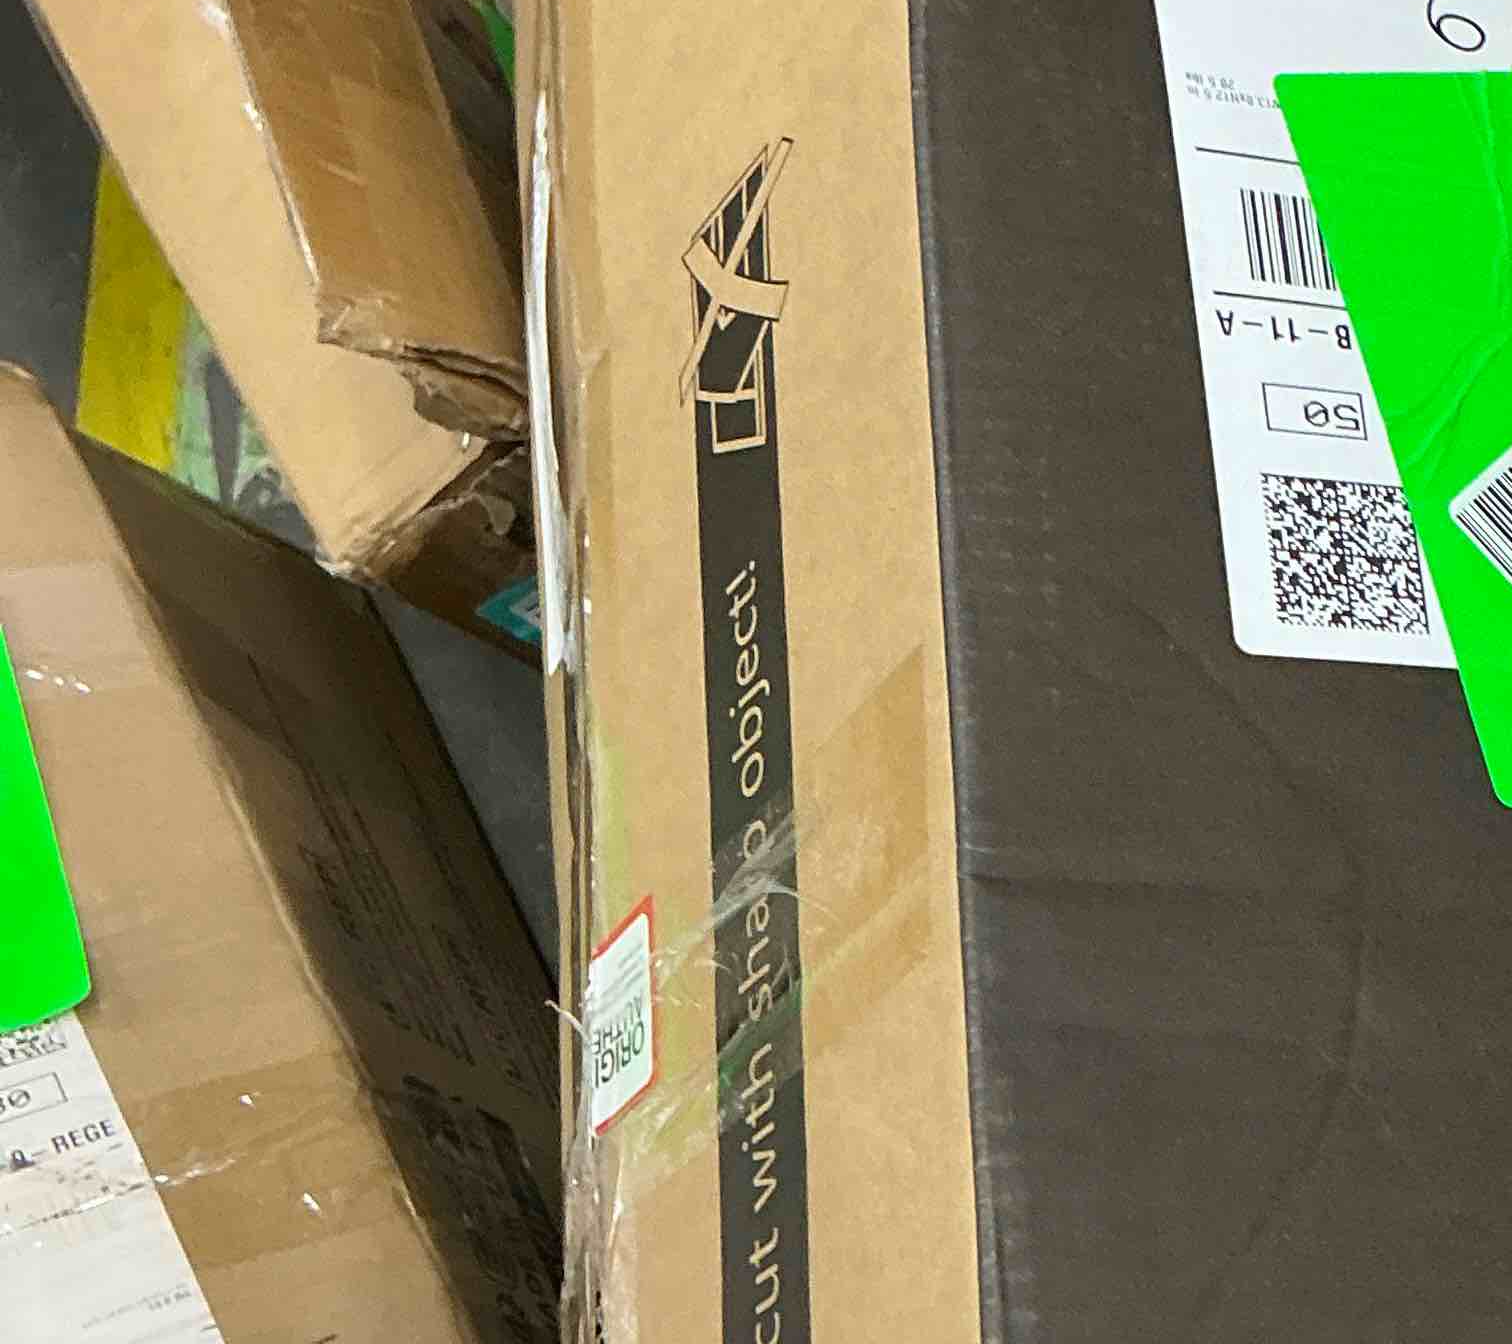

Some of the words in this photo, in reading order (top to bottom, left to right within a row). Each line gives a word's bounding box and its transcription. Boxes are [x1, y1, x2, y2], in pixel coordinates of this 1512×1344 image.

[1302, 400, 1362, 431] 50
[726, 559, 773, 798] object!
[737, 819, 777, 1023] shap
[49, 1118, 116, 1155] REGE
[739, 1042, 778, 1213] with
